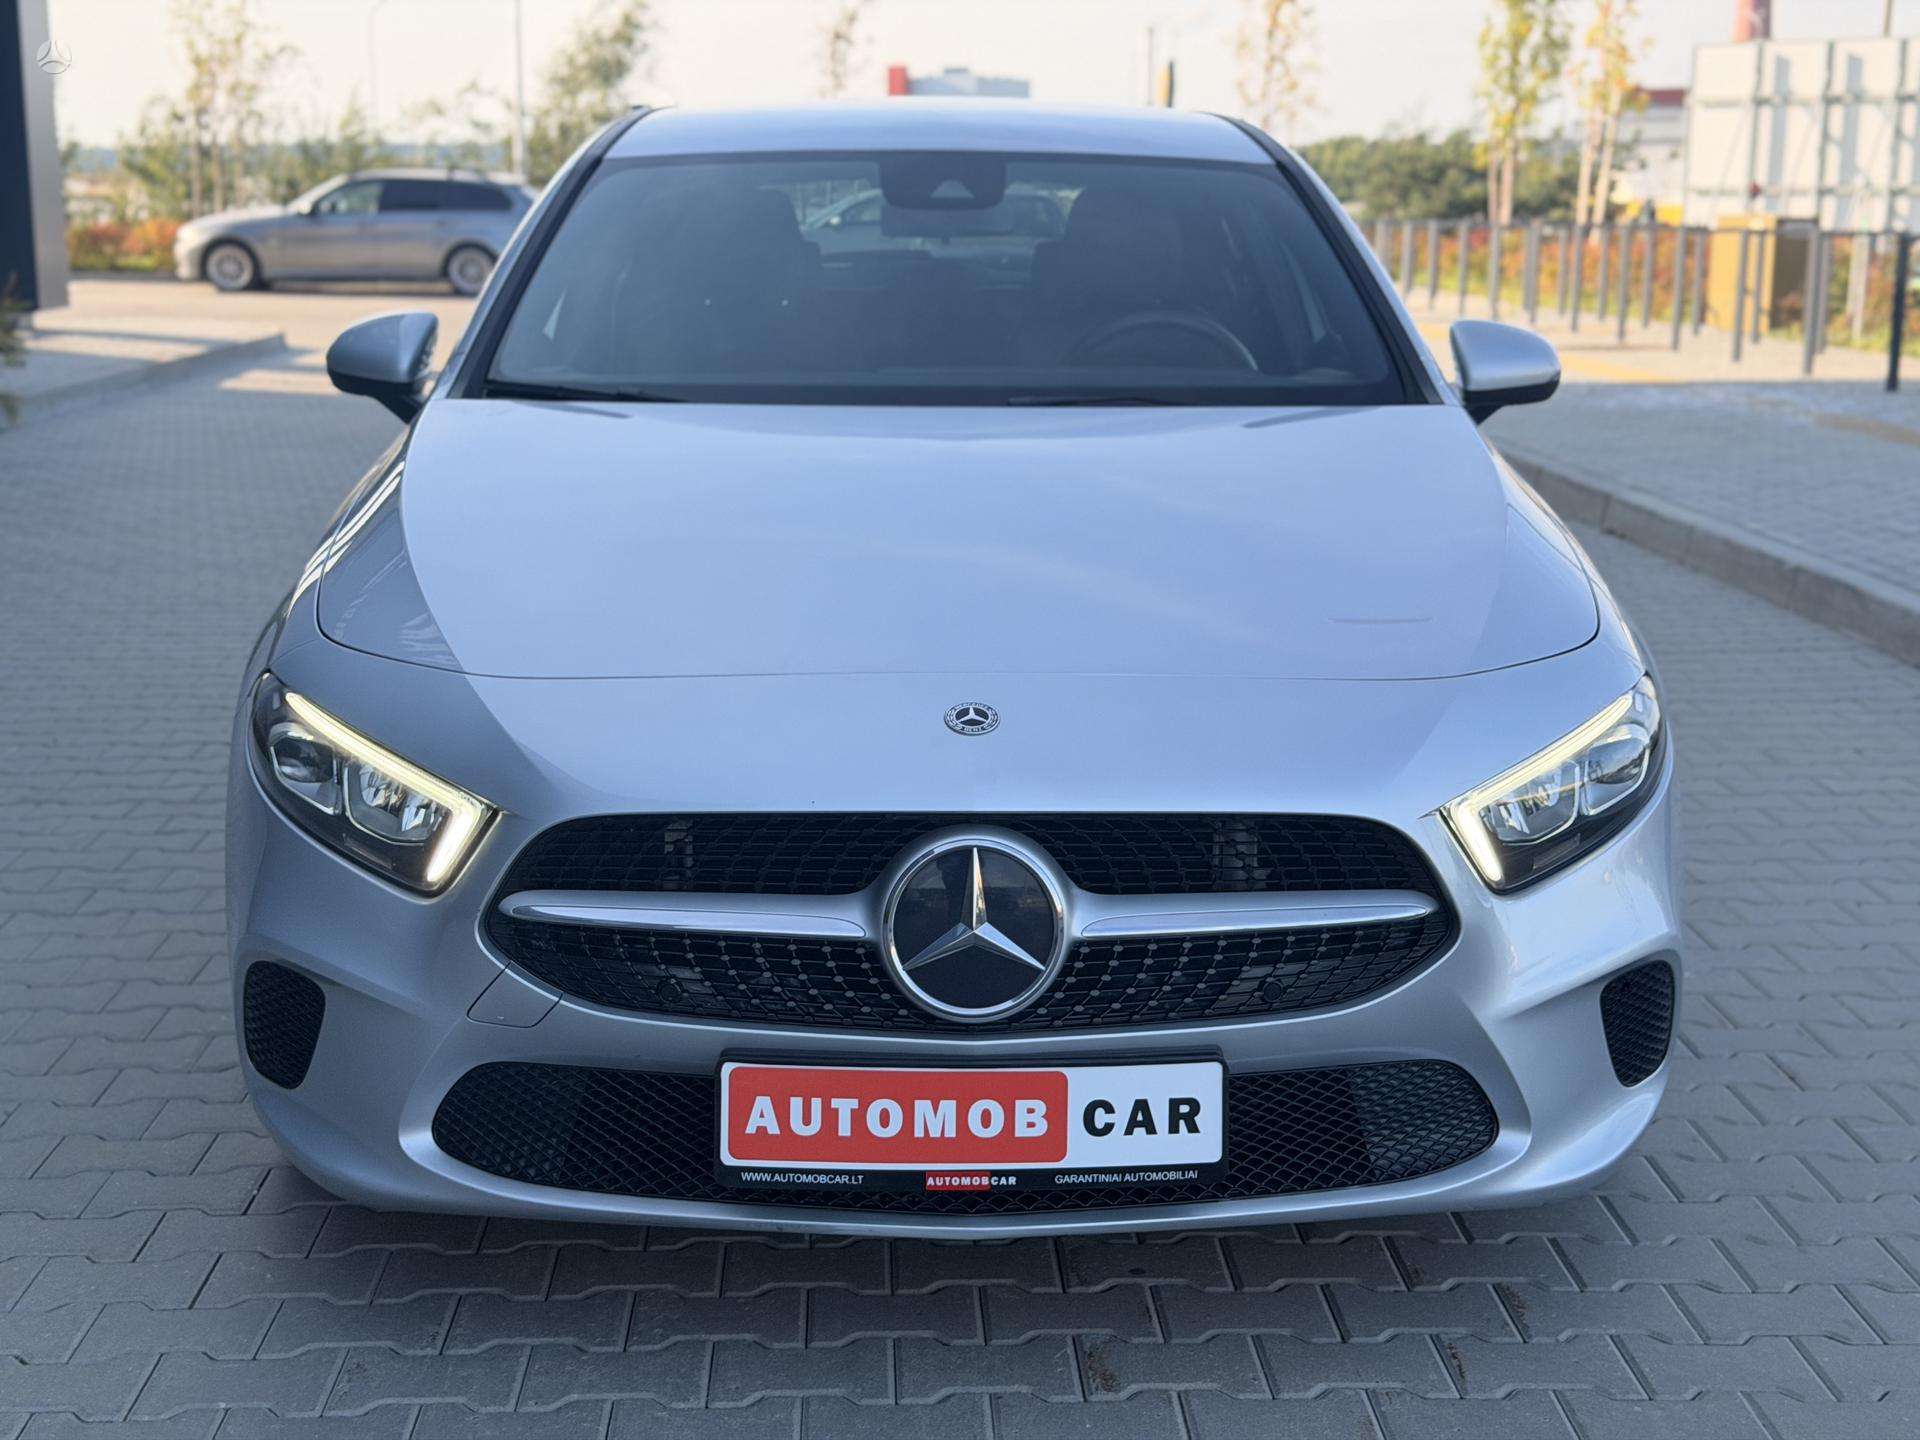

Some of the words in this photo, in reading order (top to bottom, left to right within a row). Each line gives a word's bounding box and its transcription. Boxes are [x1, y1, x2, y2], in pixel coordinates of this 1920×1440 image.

[745, 1095, 1048, 1138] AUTOMOB
[1082, 1097, 1201, 1136] CAR
[741, 1172, 864, 1185] WWW.AUTOMOBCAR.LT
[1054, 1173, 1122, 1184] GARANTINIAI
[1123, 1170, 1199, 1182] AUTOMOBILIAI
